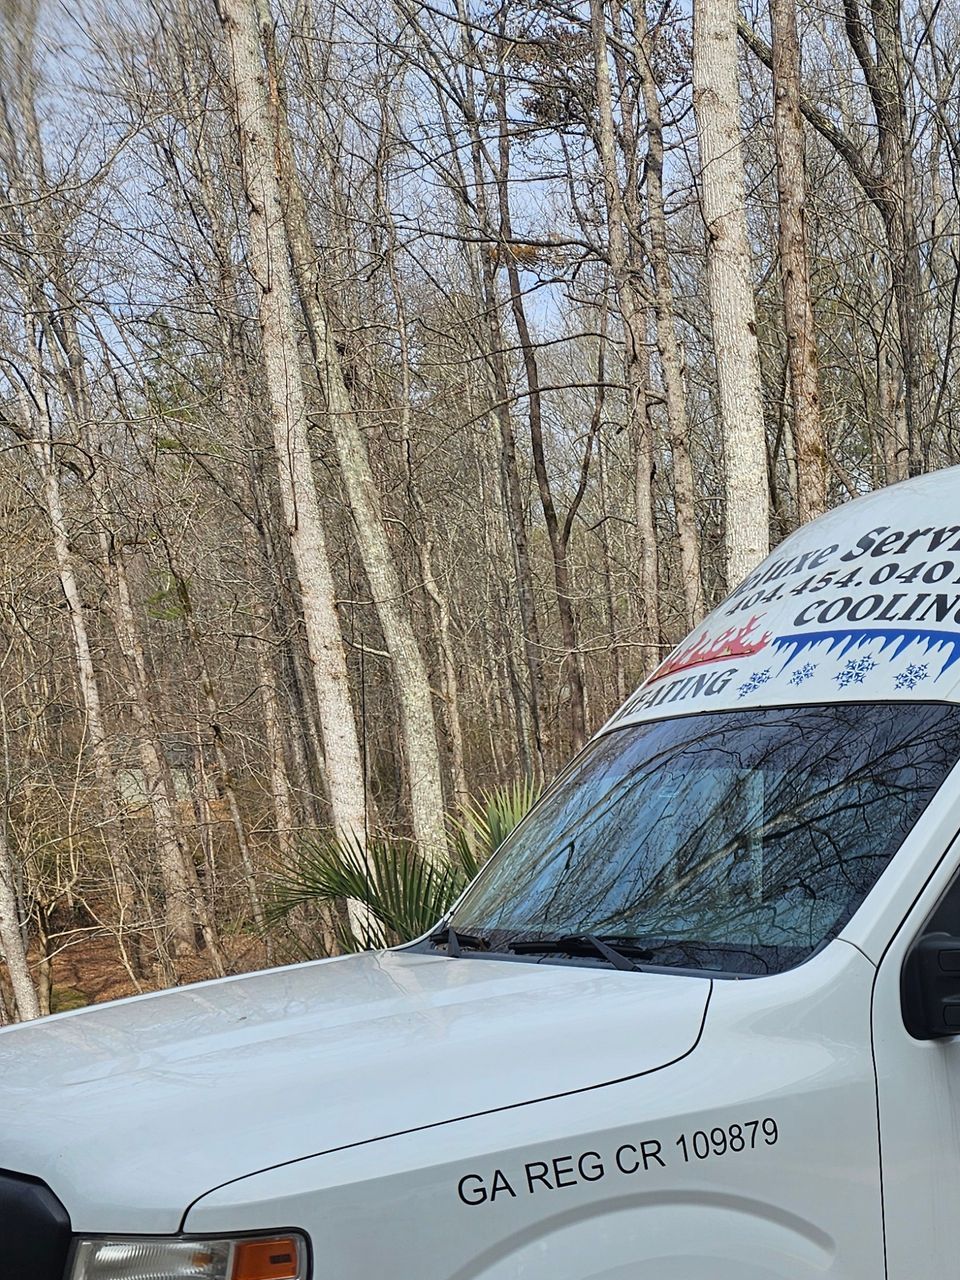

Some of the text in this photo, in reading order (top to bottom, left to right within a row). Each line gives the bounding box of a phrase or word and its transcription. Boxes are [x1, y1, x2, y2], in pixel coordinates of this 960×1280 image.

[457, 1117, 778, 1206] GA REG CR 109879
